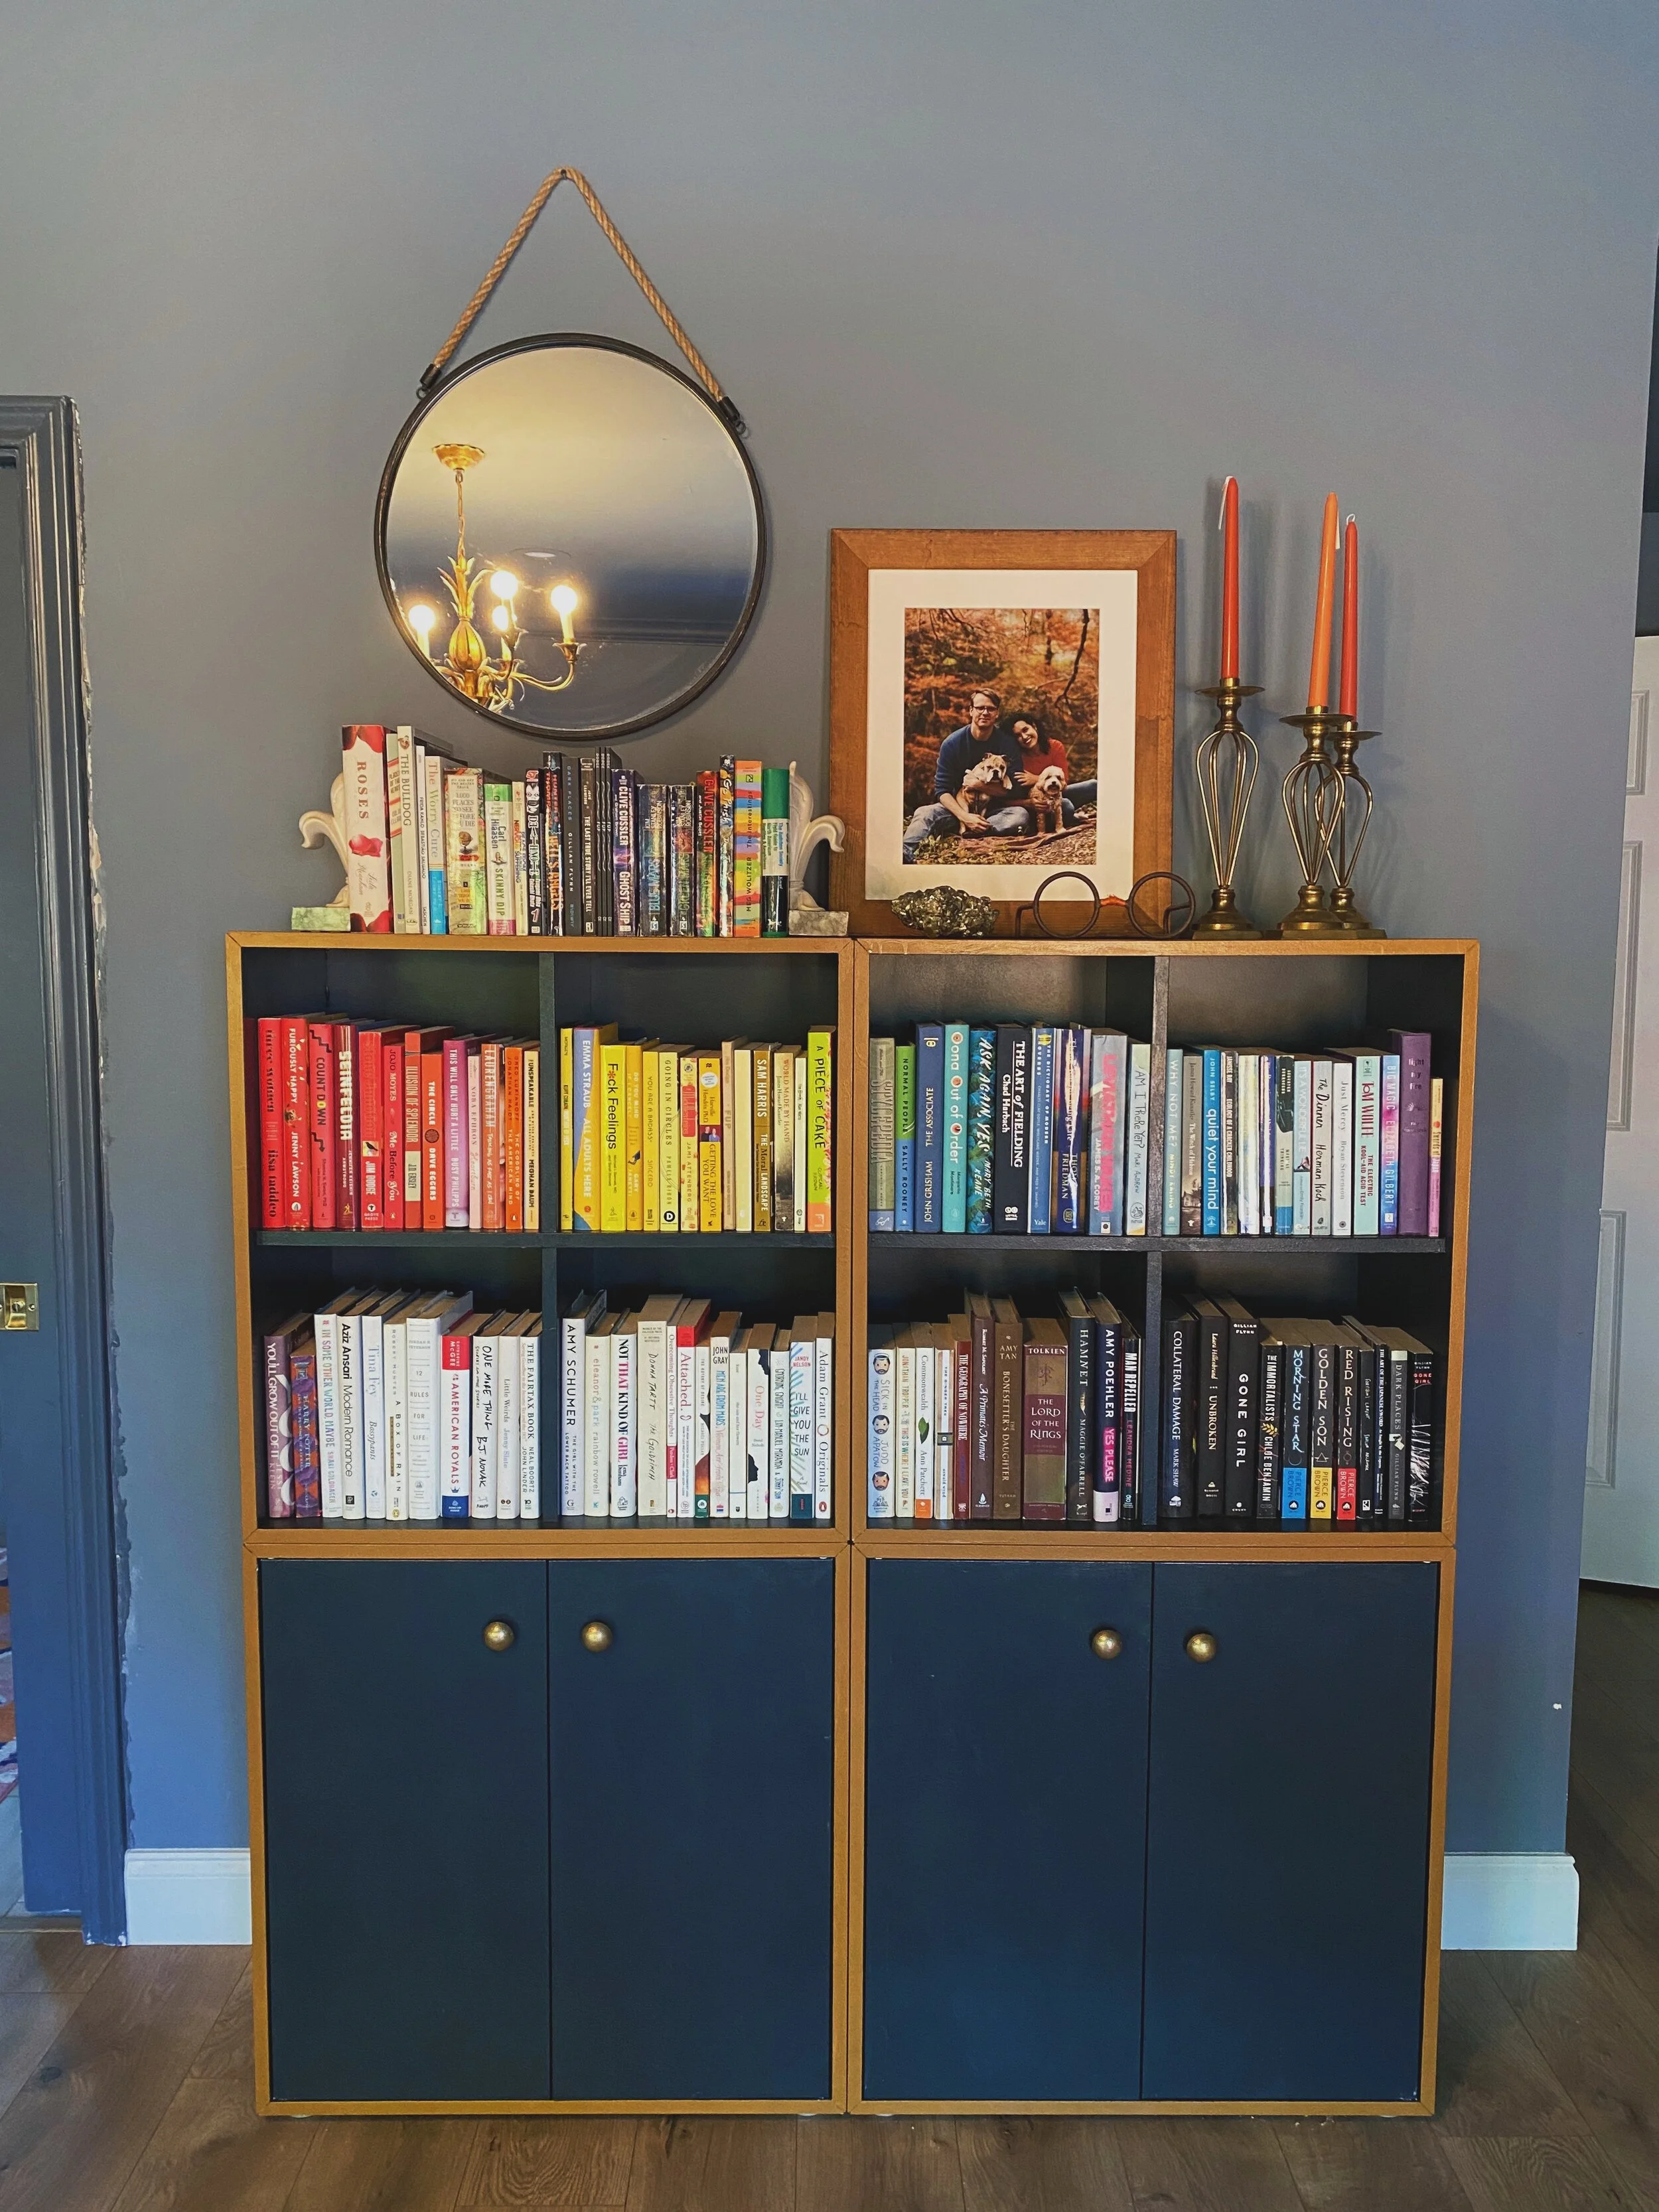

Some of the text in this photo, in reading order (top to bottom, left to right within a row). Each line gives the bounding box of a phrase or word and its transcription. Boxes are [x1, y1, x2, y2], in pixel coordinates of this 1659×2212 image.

[356, 761, 369, 820] ROSES
[401, 778, 411, 826] BULLDOG
[427, 762, 441, 857] The Worry Cure
[619, 786, 628, 846] CLIVE CUSSLER
[722, 779, 732, 822] Go Phish
[498, 826, 506, 842] Carl
[317, 1057, 326, 1125] COUNT DOWN
[405, 1066, 417, 1096] ILLUSION
[757, 1059, 766, 1117] SAM HARRIS
[1169, 1059, 1178, 1090] WHY
[1386, 1066, 1396, 1110] BIG MAGIC
[405, 1108, 418, 1142] SPLENDOR
[871, 1079, 893, 1163] STYLEPEDIA
[1013, 1041, 1025, 1167] THE ART of FIELDING
[1206, 1108, 1218, 1209] quiet your mind
[1315, 1144, 1326, 1202] Herman Koch
[1385, 1120, 1395, 1204] ELIZABETH GILBERT
[342, 1323, 352, 1379] Aziz Ansari
[366, 1345, 380, 1396] Tina Fey
[566, 1325, 576, 1426] AMY SCHUMER
[648, 1353, 658, 1378] DONNA
[713, 1347, 727, 1356] JOHN
[959, 1354, 968, 1366] THE
[958, 1367, 968, 1401] GEOGRAPHY
[1172, 1331, 1182, 1440] COLLATERAL DAMAGE
[1317, 1349, 1329, 1446] GOLDEN SON
[343, 1385, 354, 1477] Modern Romance
[794, 1420, 810, 1430] YOU
[794, 1434, 809, 1443] THE
[958, 1412, 968, 1440] NOWHERE
[1106, 1429, 1114, 1445] YES
[1208, 1396, 1218, 1449] UNBROKEN
[1236, 1374, 1248, 1467] GONE GIRL
[1344, 1386, 1352, 1447] RISING
[818, 1441, 828, 1492] Originals
